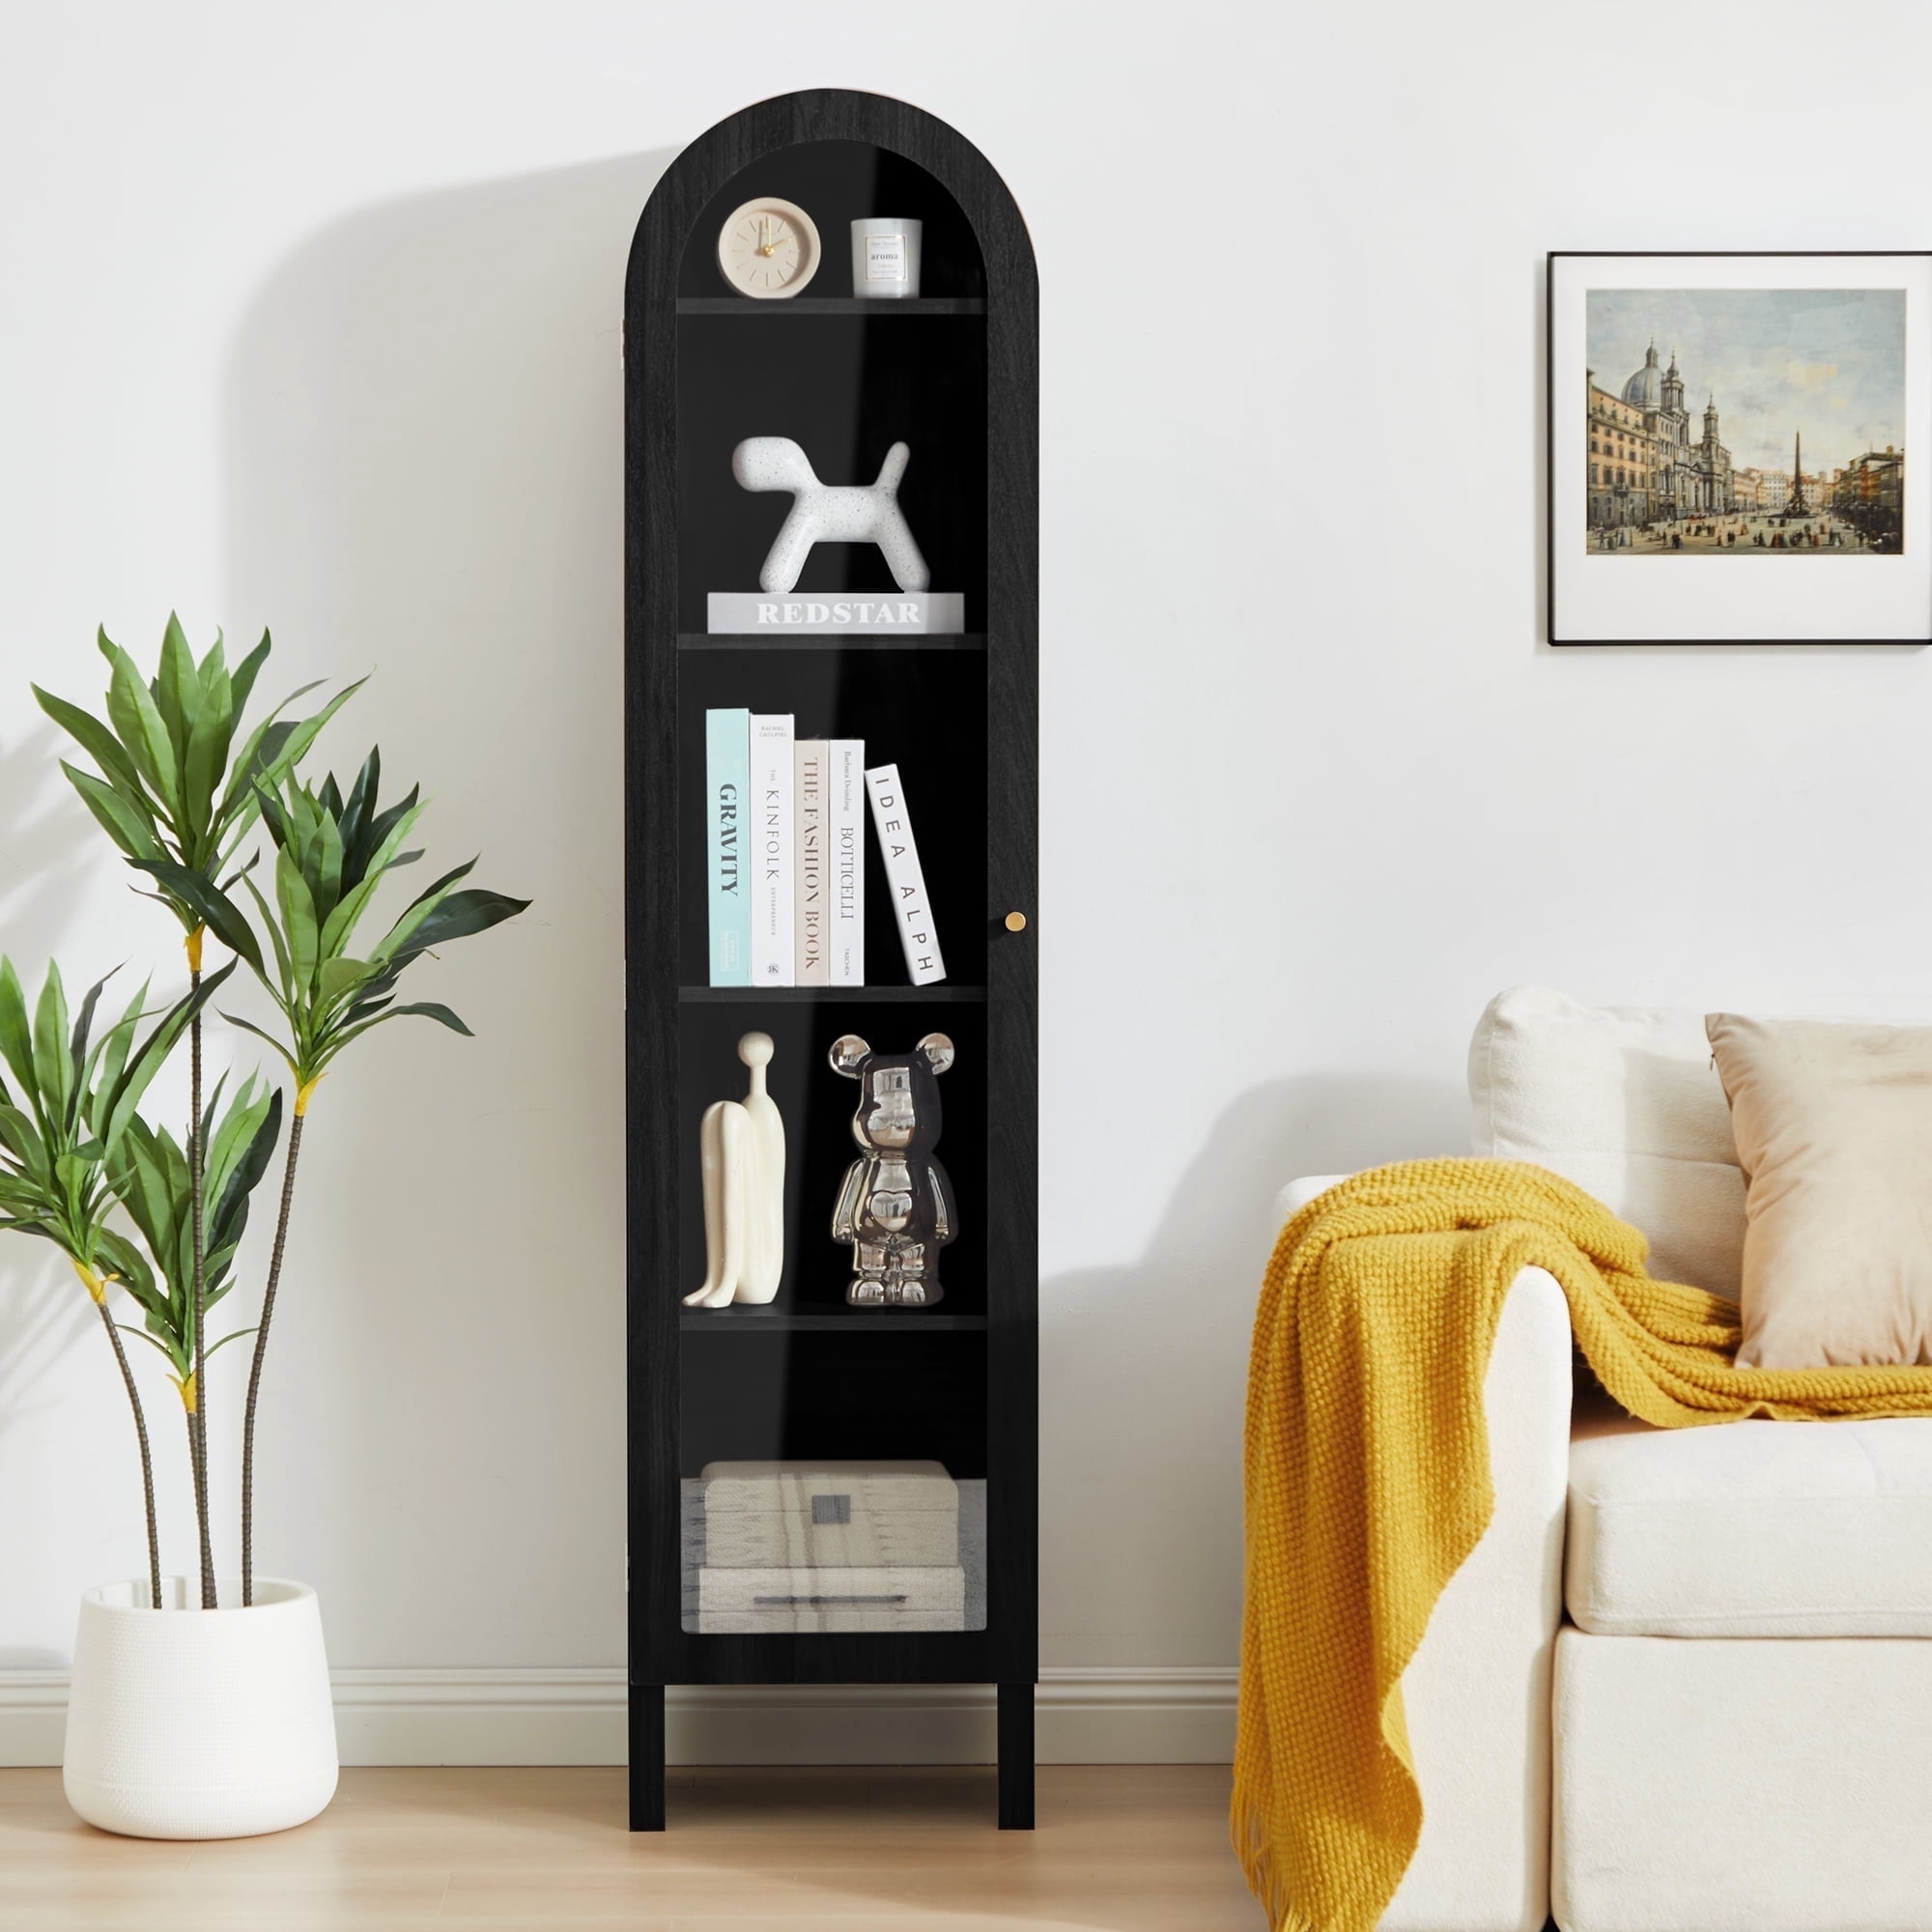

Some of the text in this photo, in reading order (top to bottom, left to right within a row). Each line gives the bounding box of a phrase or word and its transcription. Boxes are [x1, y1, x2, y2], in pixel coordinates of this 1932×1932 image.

[757, 603, 921, 624] REDSTAR
[719, 783, 739, 896] GRAVITY
[766, 790, 780, 880] KINFOLK
[804, 757, 819, 970] THE FASHION BOOK
[840, 827, 854, 919] BOTTICELLI
[875, 778, 933, 970] IDEA ALPH
